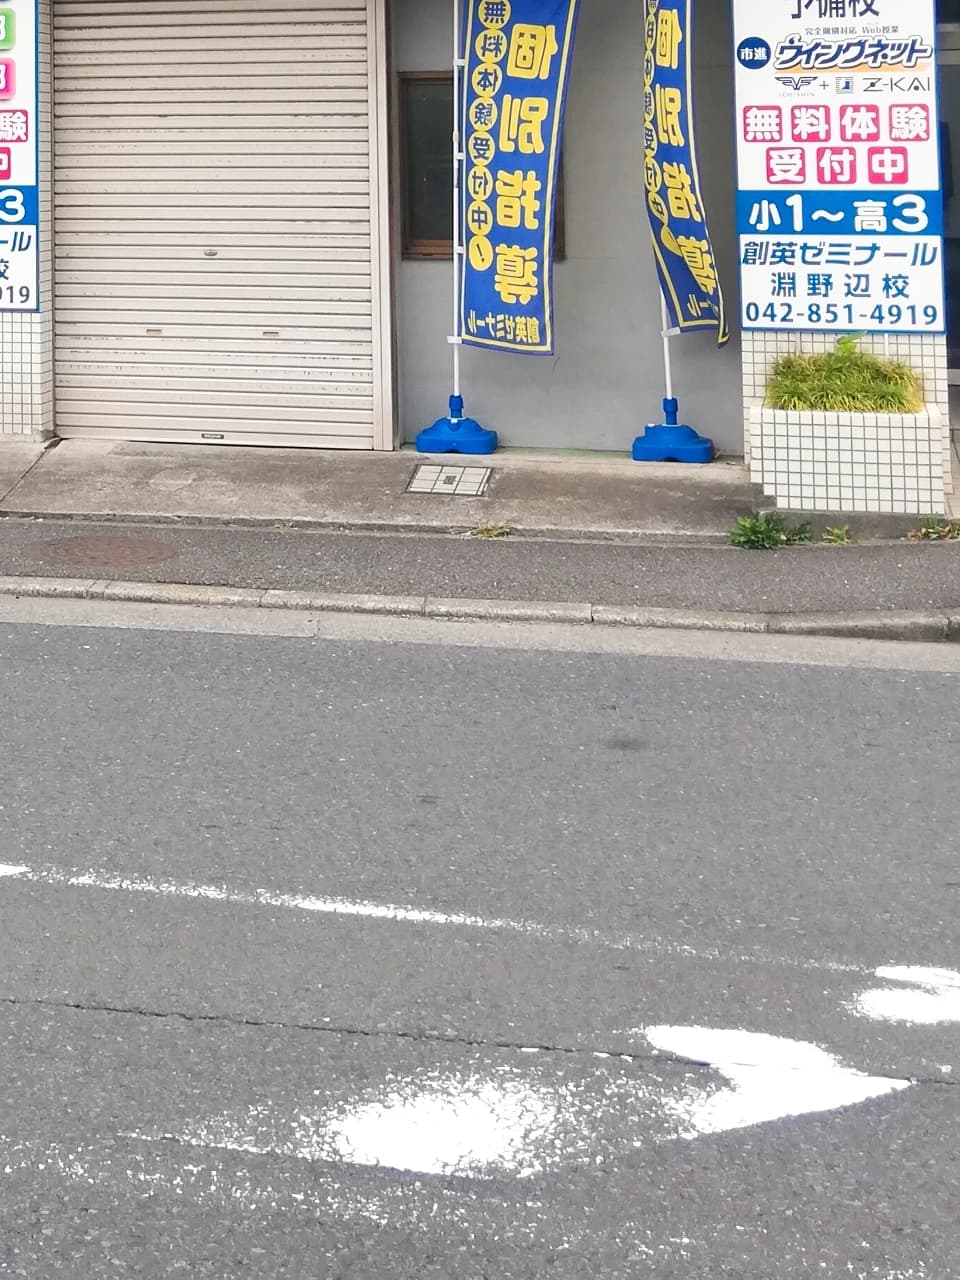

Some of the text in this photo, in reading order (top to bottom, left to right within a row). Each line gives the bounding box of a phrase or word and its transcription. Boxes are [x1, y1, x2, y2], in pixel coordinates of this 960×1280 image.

[743, 105, 929, 142] 無料体験
[766, 147, 908, 184] 受付中
[742, 241, 938, 266] 創英ゼミナール
[770, 272, 910, 299] 淵野辺校
[745, 302, 938, 325] 042-851-4919
